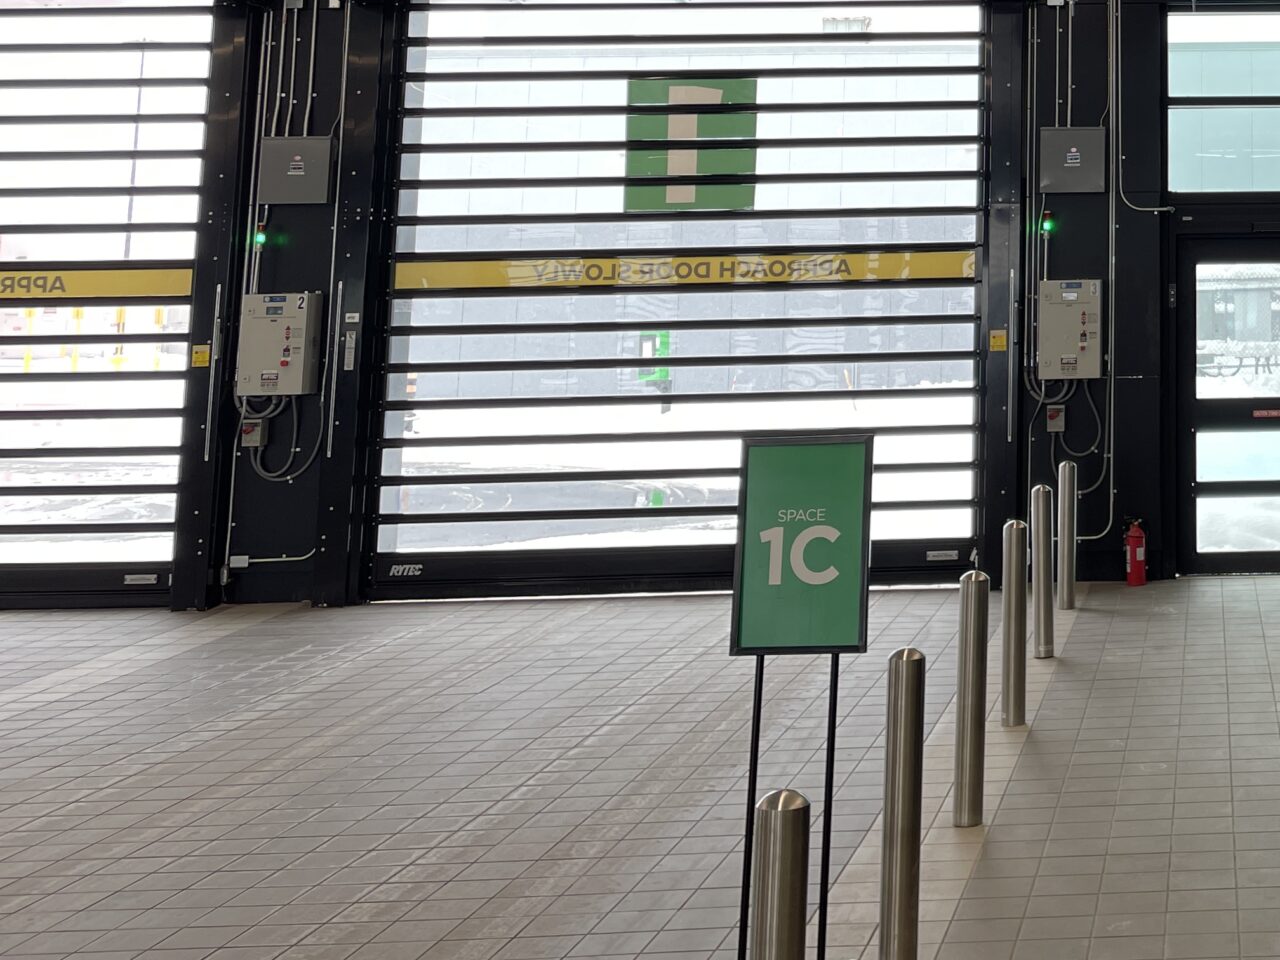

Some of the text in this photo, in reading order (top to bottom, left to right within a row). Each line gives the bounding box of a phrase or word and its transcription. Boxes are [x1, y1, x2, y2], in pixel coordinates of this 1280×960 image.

[298, 296, 305, 309] 2
[778, 507, 827, 523] SPACE
[760, 524, 841, 586] 1C
[389, 564, 424, 577] RYTEC
